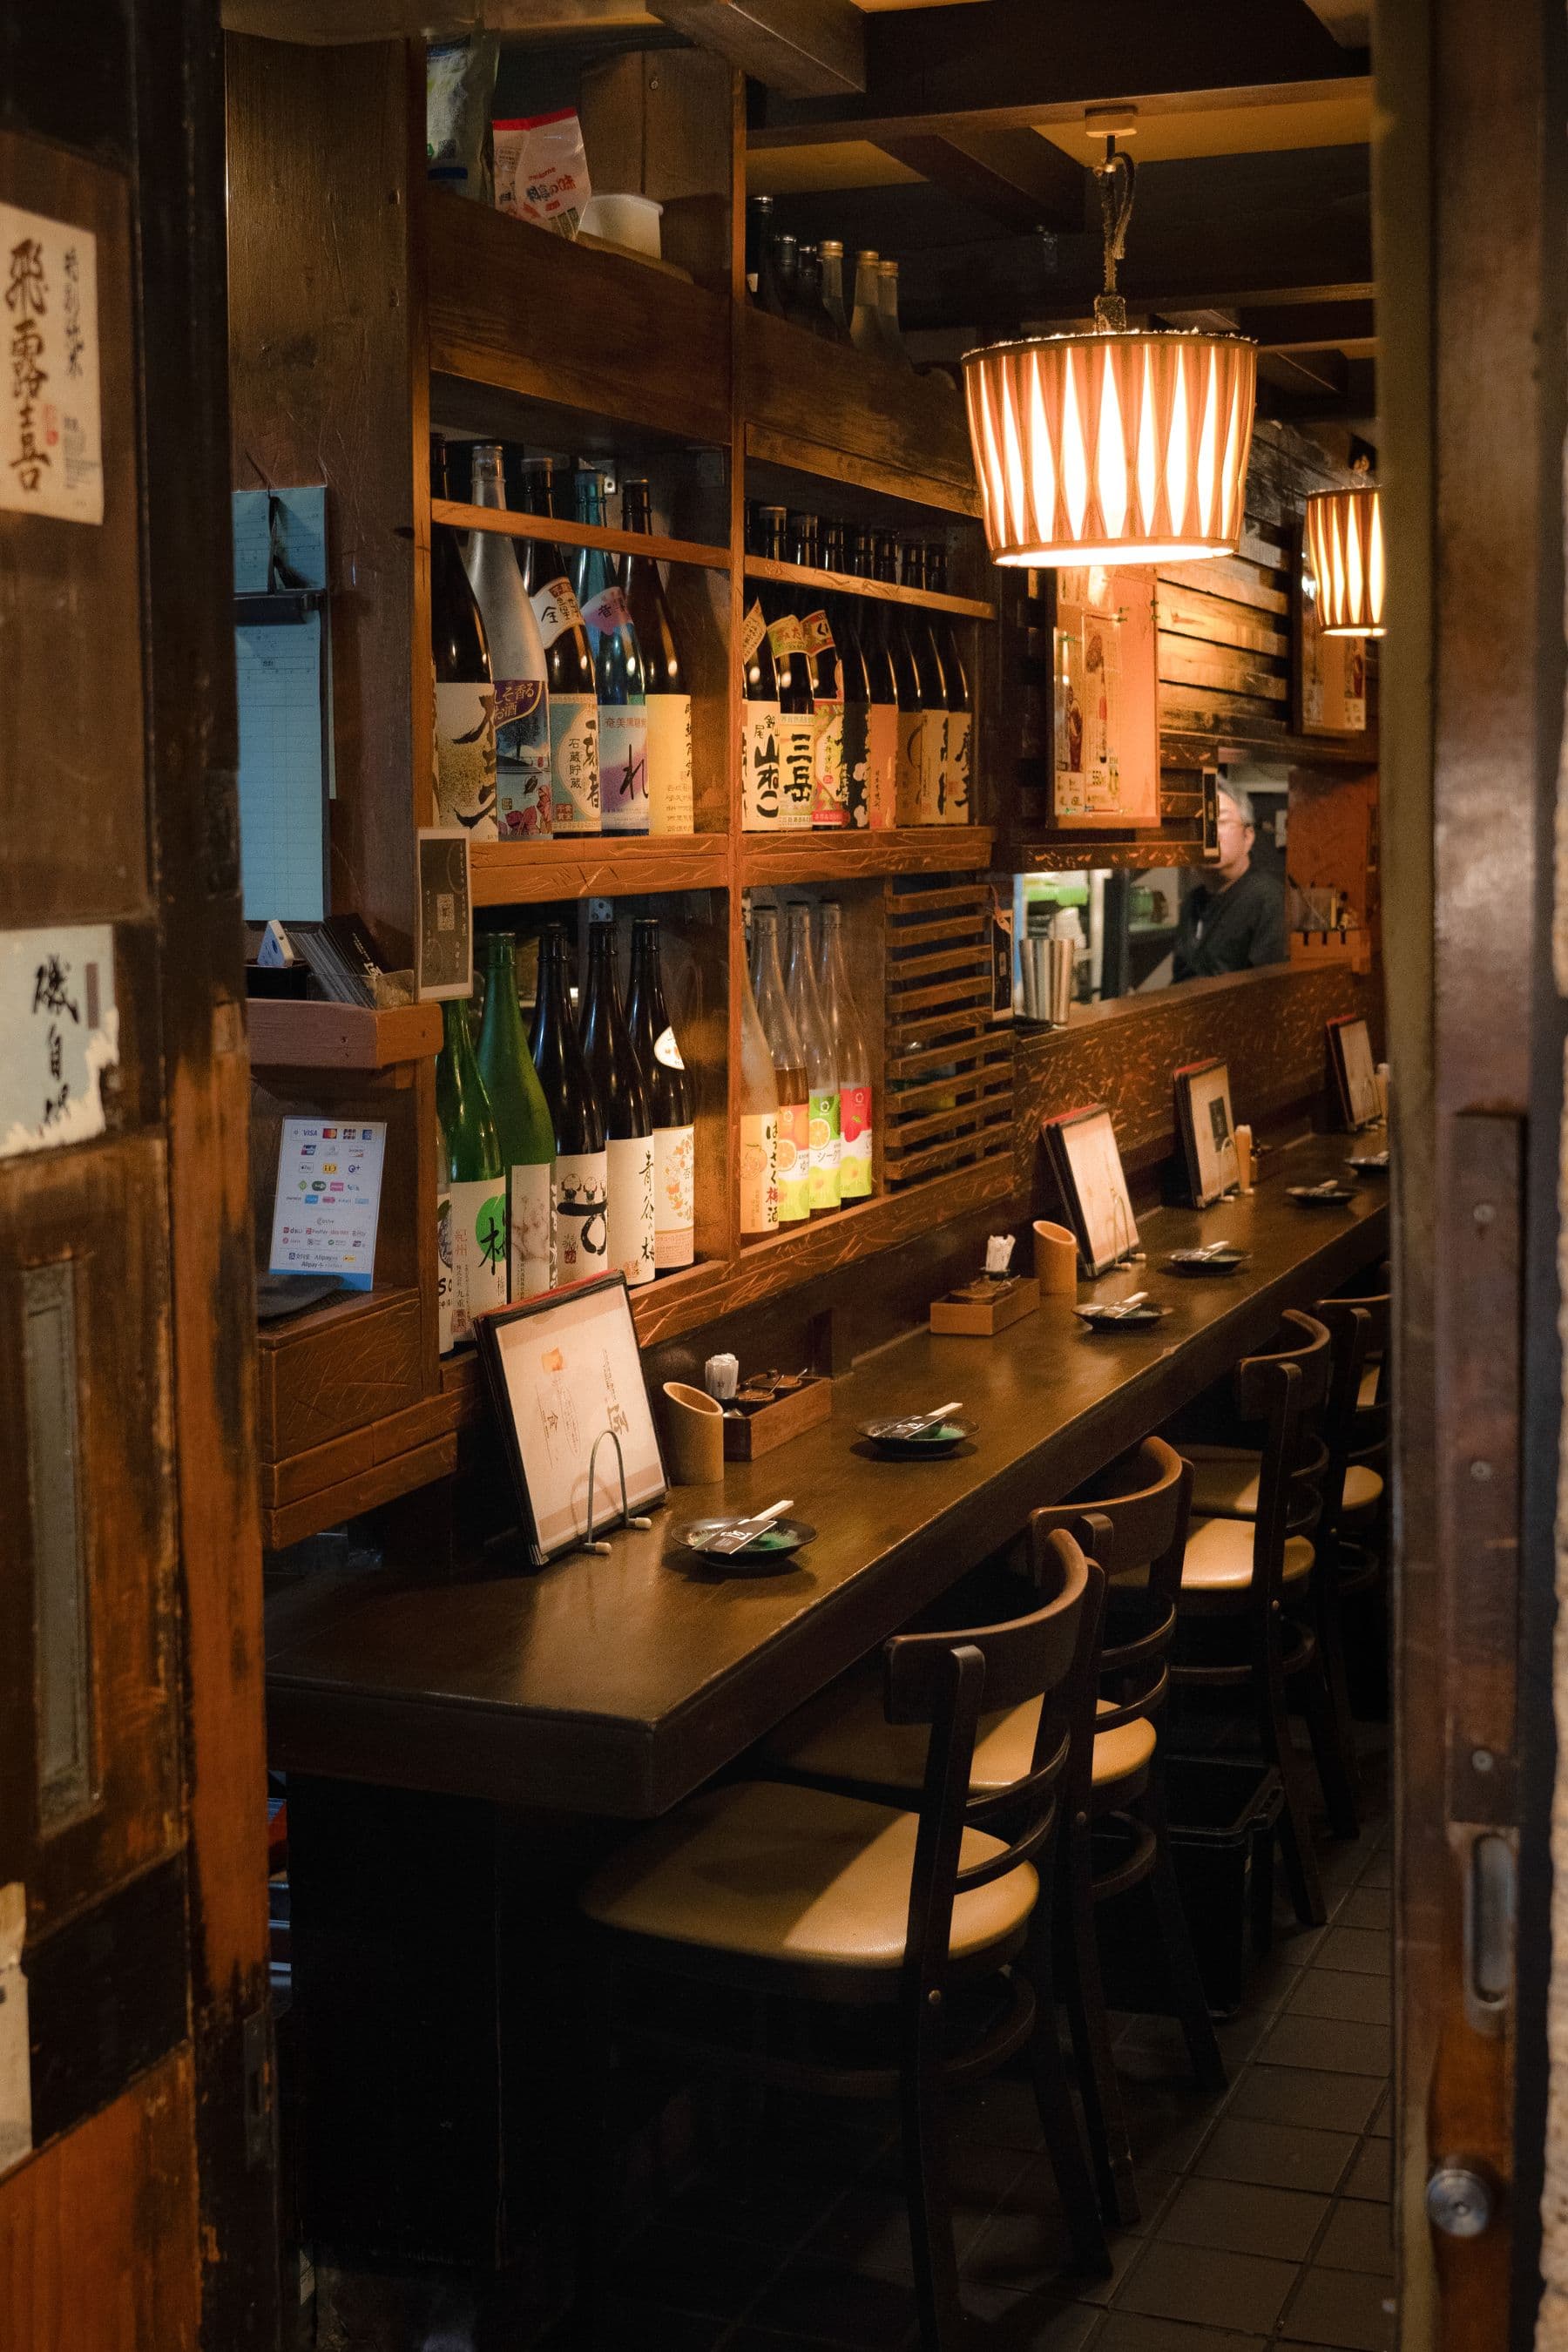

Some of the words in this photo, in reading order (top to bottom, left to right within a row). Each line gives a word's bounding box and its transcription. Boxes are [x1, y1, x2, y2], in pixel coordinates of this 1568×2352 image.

[568, 737, 583, 790] 石蔵貯蔵
[754, 733, 781, 819] 山ねこ
[782, 733, 813, 802] 三岳
